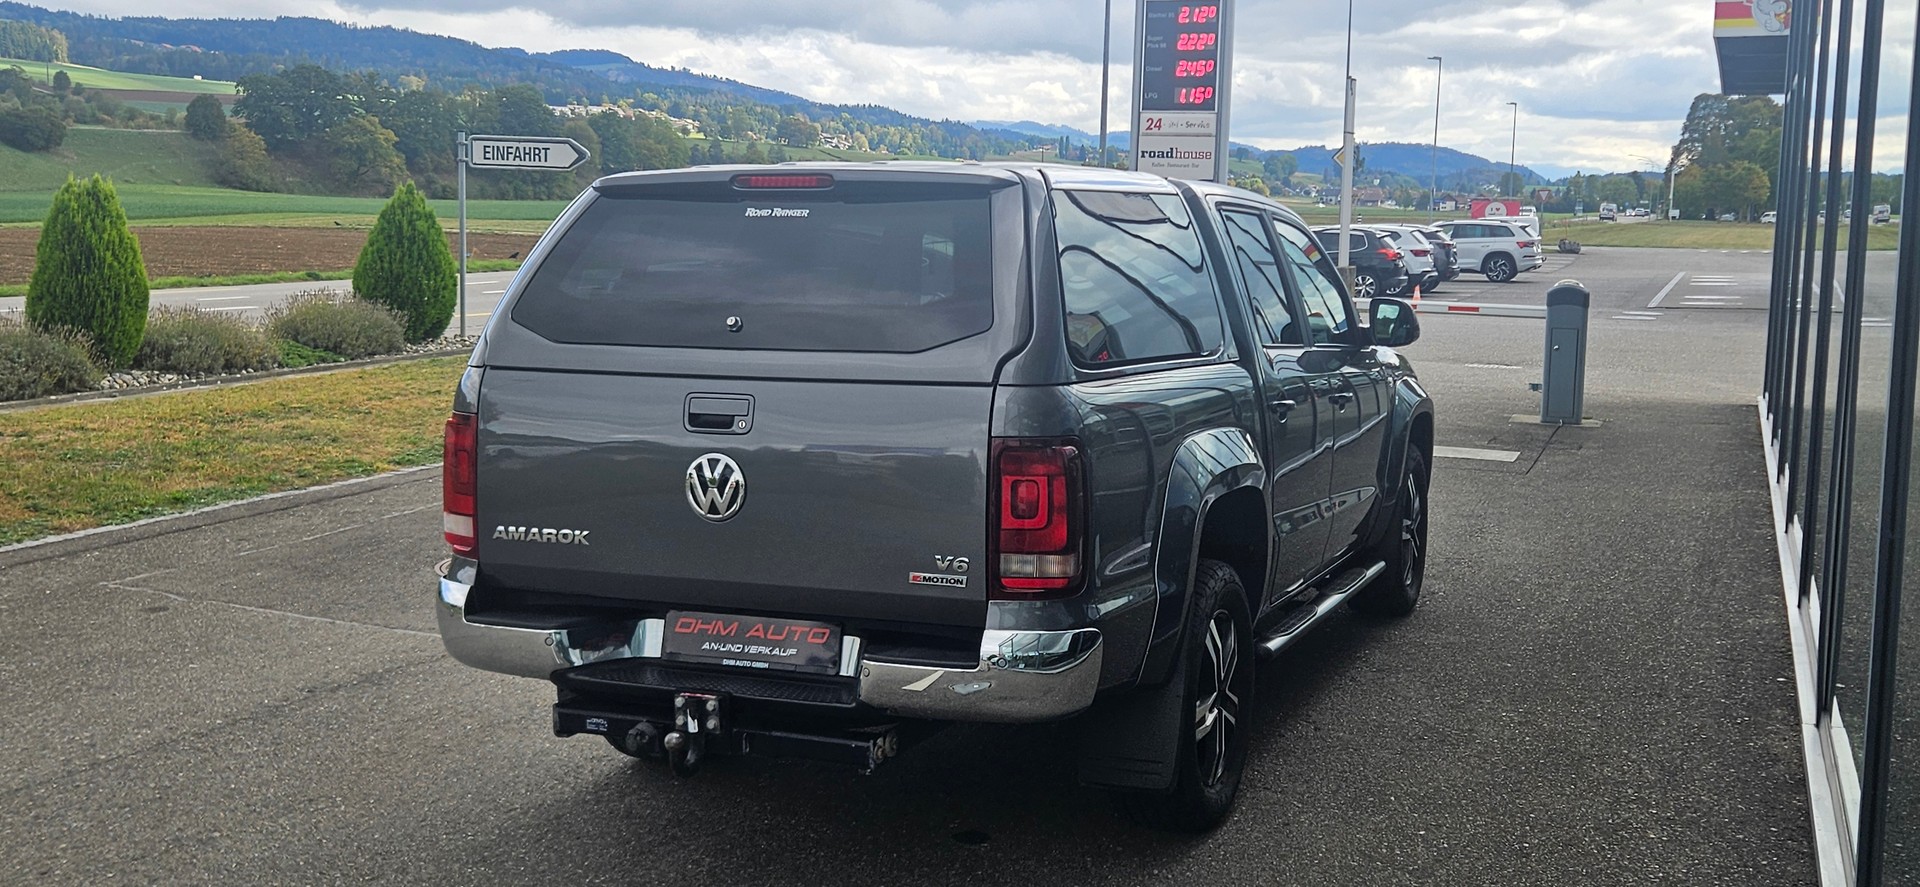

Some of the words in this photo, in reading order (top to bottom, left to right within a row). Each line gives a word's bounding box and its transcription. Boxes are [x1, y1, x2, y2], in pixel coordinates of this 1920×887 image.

[483, 145, 550, 163] EINFAHRT
[1140, 147, 1212, 160] roadhouse
[492, 525, 590, 546] AMAROK
[934, 555, 970, 572] V6
[745, 623, 831, 644] AUTO
[744, 644, 798, 657] VERKAUF
